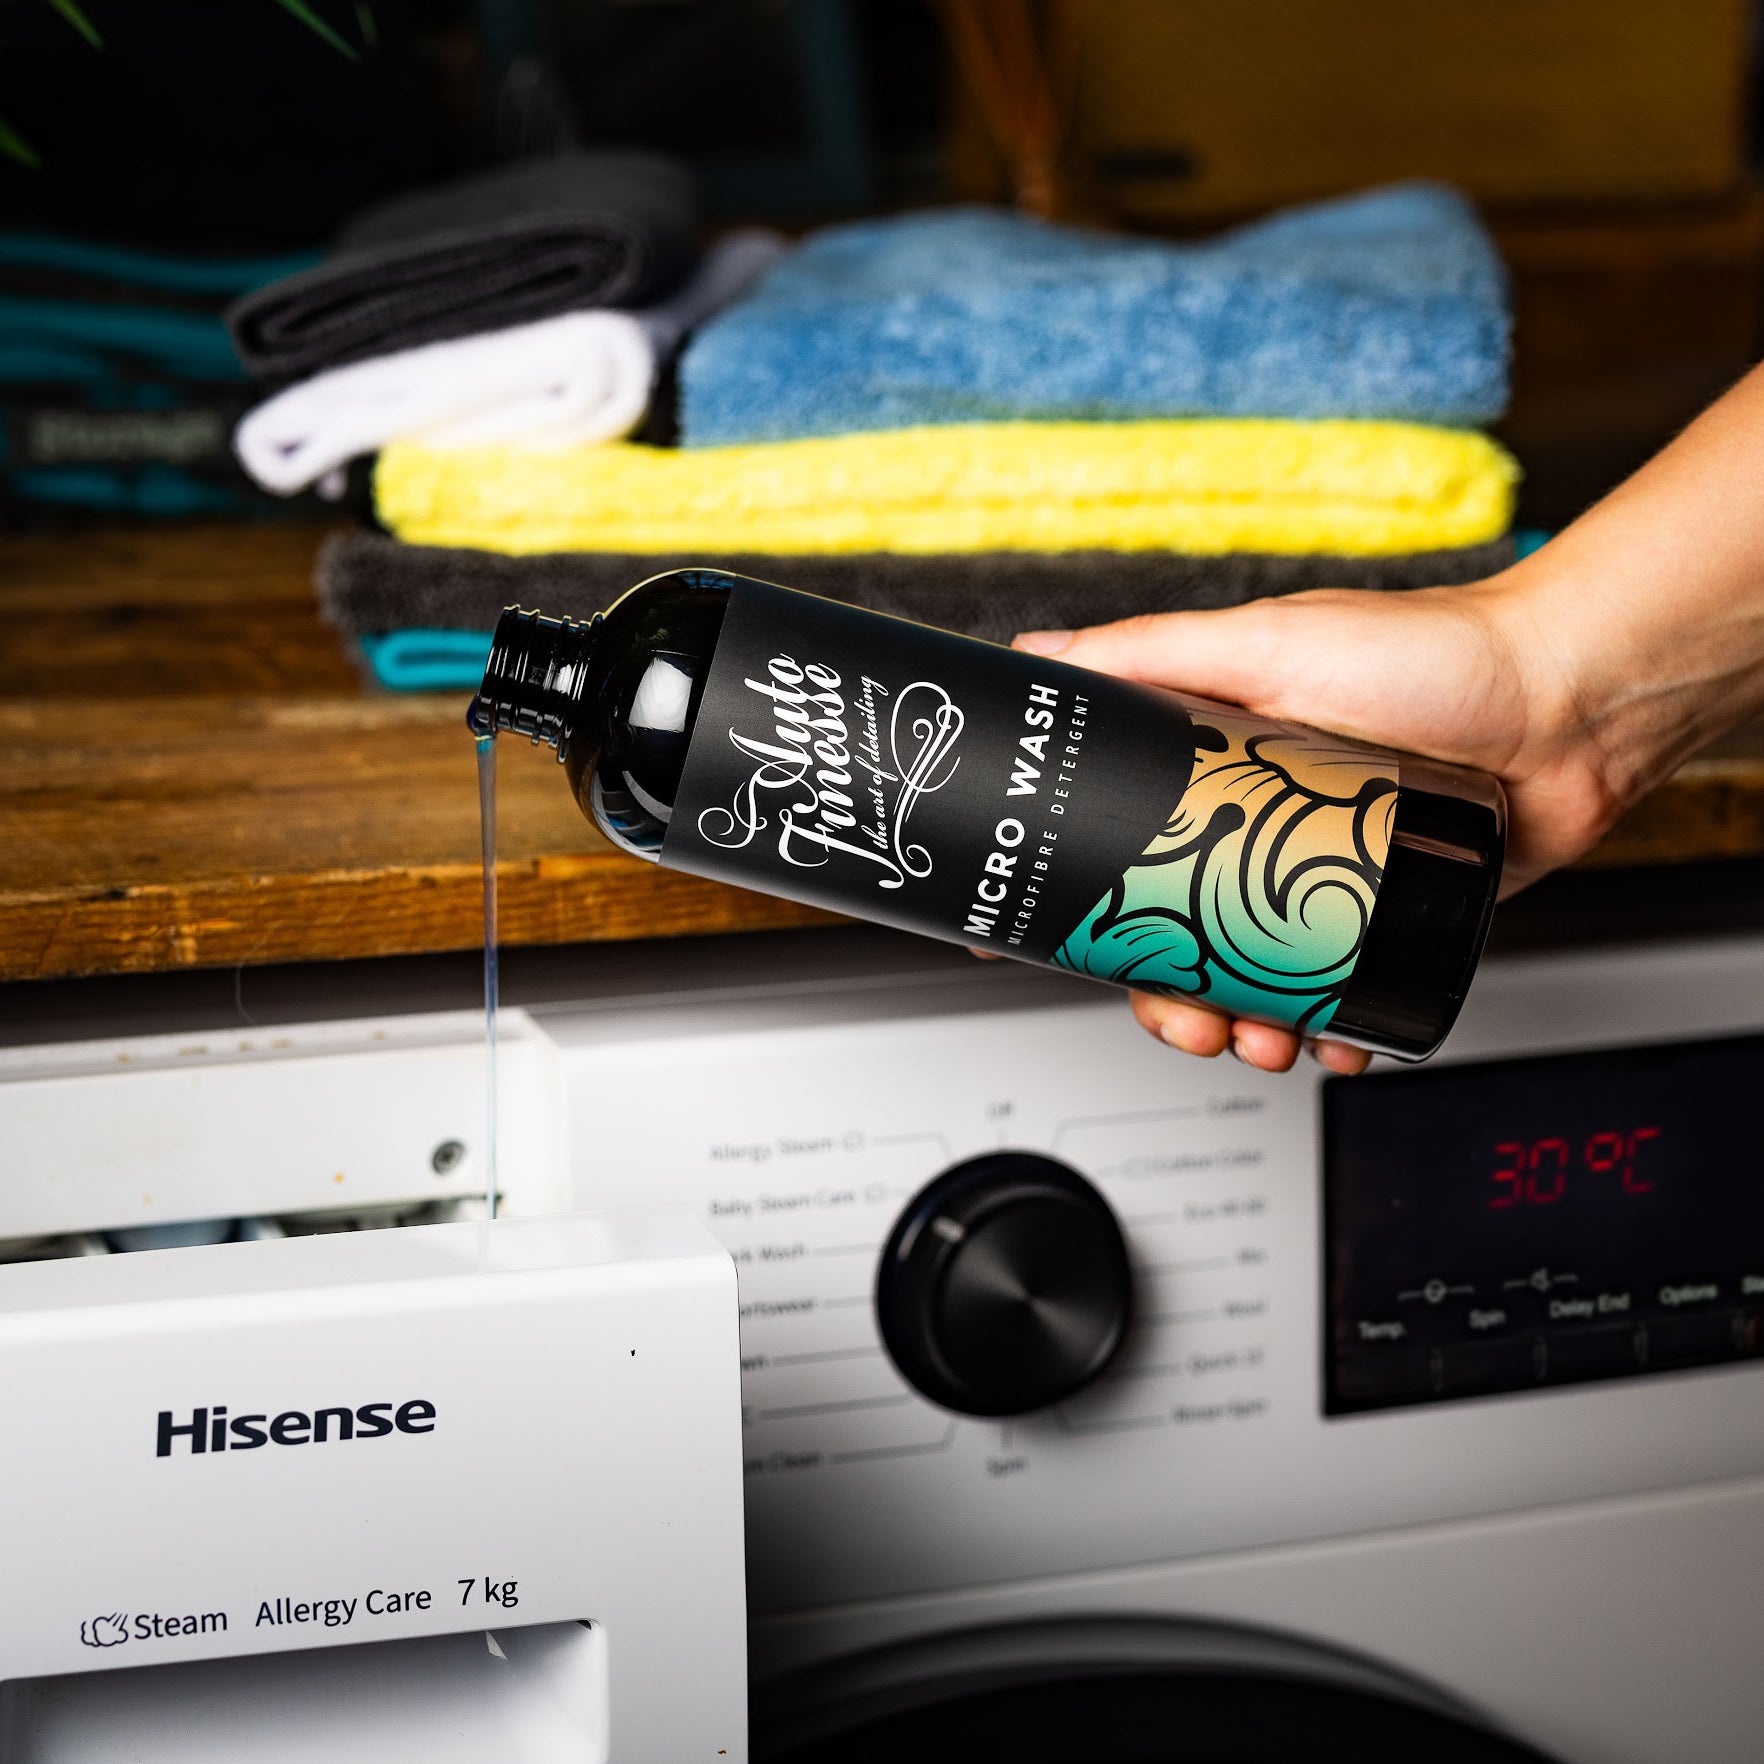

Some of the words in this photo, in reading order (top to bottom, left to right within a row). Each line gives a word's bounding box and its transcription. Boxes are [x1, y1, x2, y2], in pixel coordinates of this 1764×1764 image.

[698, 653, 818, 848] Auto
[853, 675, 889, 763] detailing
[778, 662, 904, 889] Finesse
[854, 754, 899, 786] of
[867, 786, 886, 819] art
[861, 821, 889, 850] the
[963, 817, 1026, 937] MICRO
[1006, 683, 1060, 797] WASH
[1007, 830, 1058, 946] MICROFIBRE
[1050, 694, 1090, 815] DETERGENT
[1488, 1140, 1568, 1208] 30
[1598, 1293, 1630, 1312] End
[156, 1399, 436, 1458] Hisense
[134, 1611, 228, 1640] Steam
[255, 1596, 358, 1627] Allergy
[365, 1588, 432, 1615] Care
[457, 1578, 476, 1606] 7
[484, 1576, 519, 1608] kg
